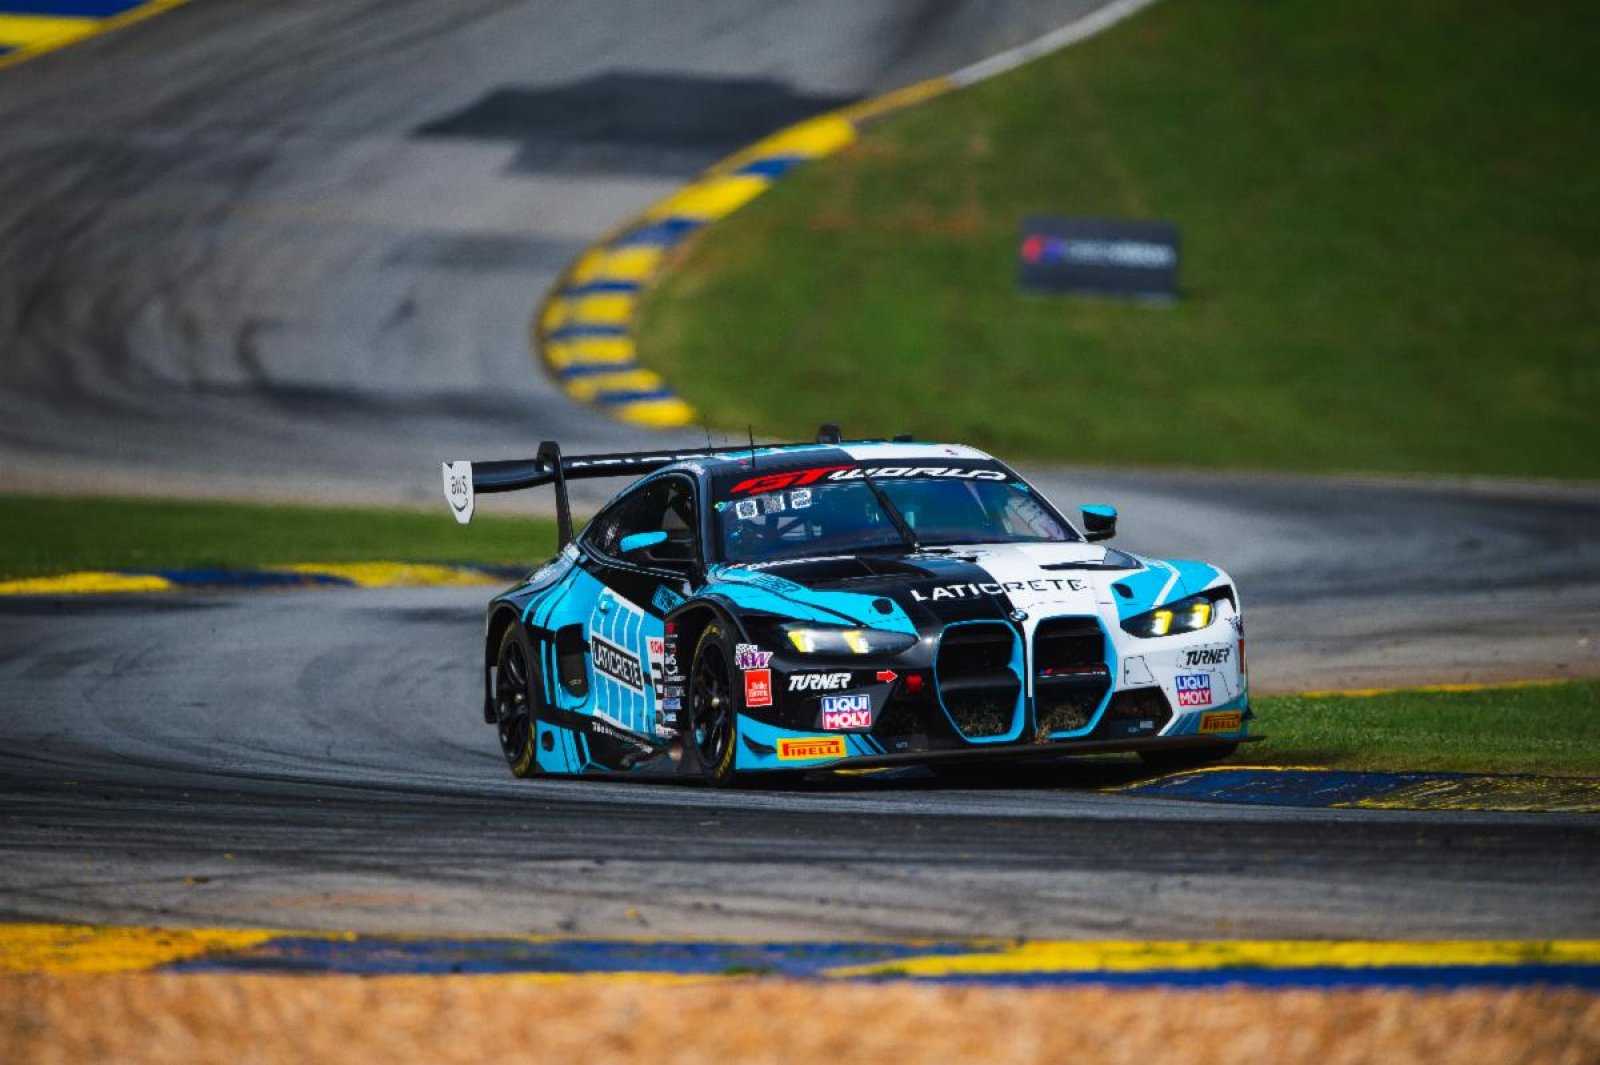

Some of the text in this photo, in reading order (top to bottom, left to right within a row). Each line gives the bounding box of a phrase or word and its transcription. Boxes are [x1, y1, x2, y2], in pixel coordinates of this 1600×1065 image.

[910, 579, 1087, 601] LATICRETE
[593, 641, 641, 686] LATICRETE
[1186, 649, 1230, 666] TURNER
[788, 672, 851, 691] TURNER
[1176, 675, 1209, 690] LIQUI
[824, 697, 868, 712] LIQUI
[1179, 690, 1211, 705] MOLY
[825, 711, 870, 727] MOLY
[782, 740, 841, 757] PIRELLI
